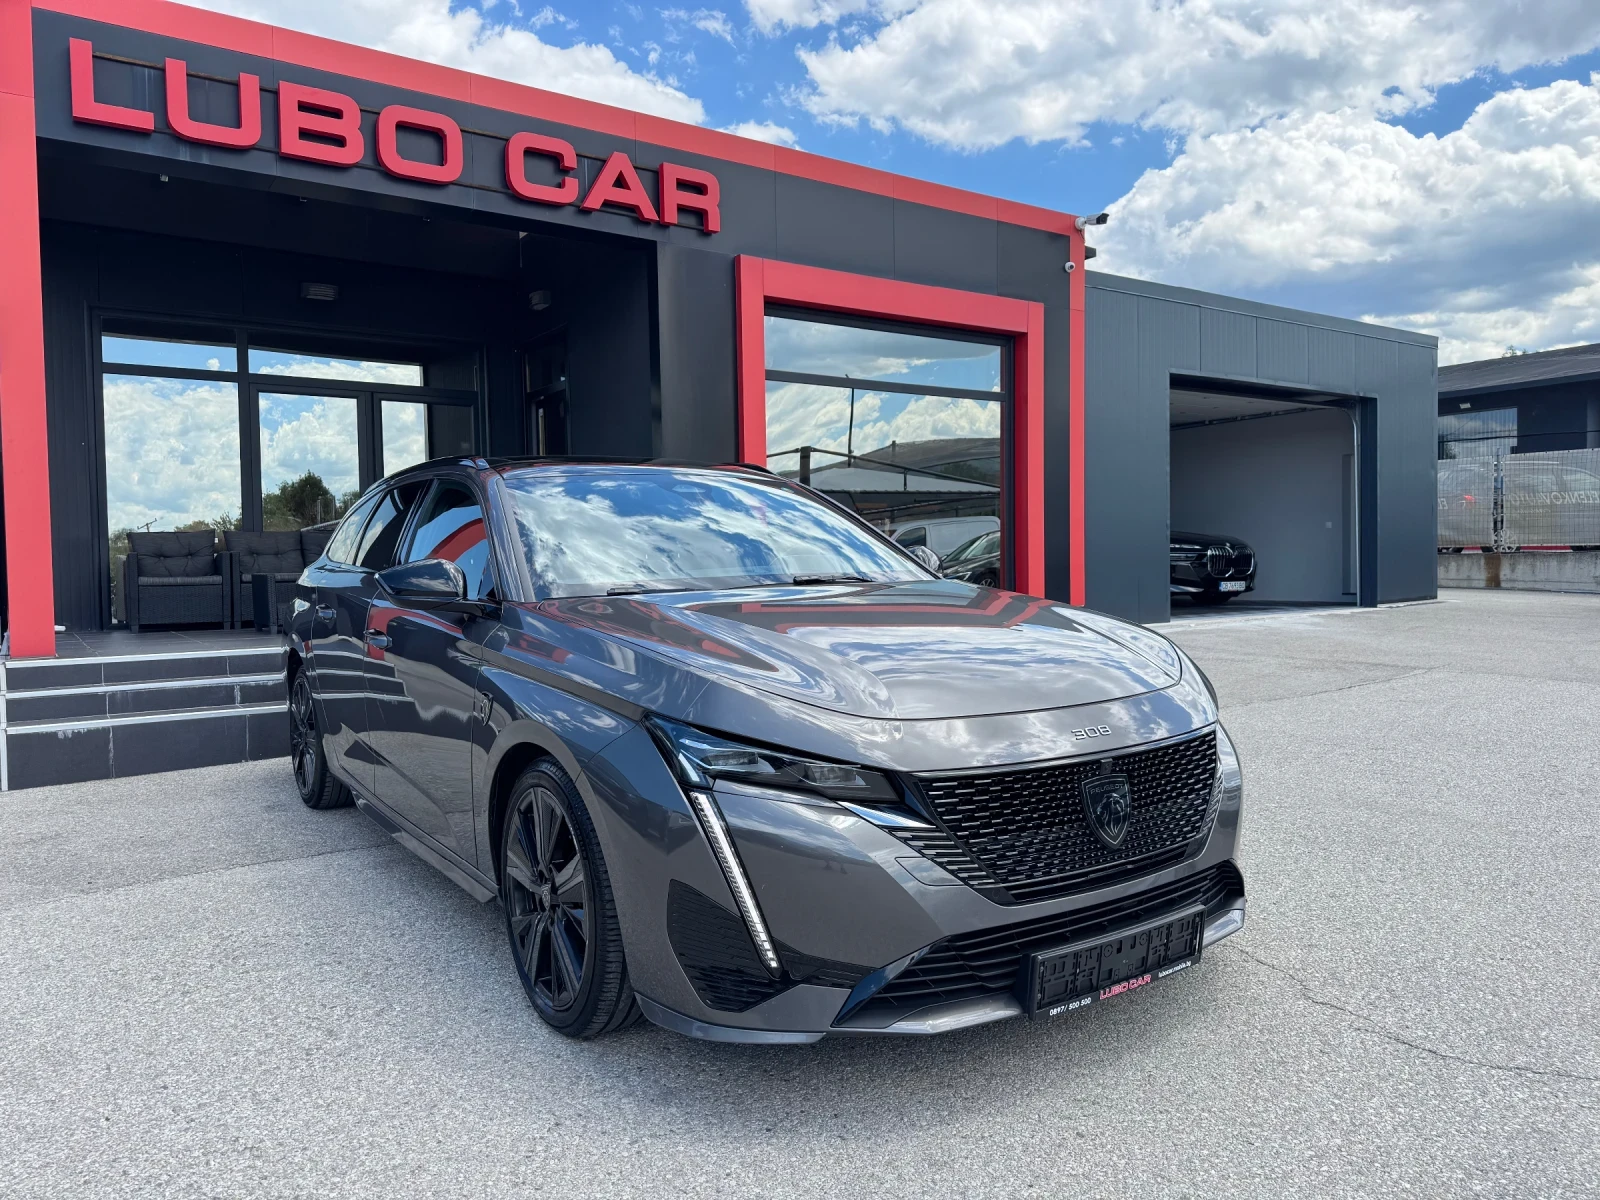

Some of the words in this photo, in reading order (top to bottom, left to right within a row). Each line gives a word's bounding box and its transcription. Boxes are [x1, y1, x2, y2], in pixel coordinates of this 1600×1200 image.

[69, 38, 464, 186] LUBO
[504, 131, 721, 234] CAR
[1071, 724, 1112, 740] 308
[1090, 783, 1124, 795] PEUGEOT
[1100, 981, 1128, 1000] LUBO
[1129, 974, 1152, 990] CAR
[1068, 1000, 1080, 1010] 500
[1080, 996, 1092, 1006] 500
